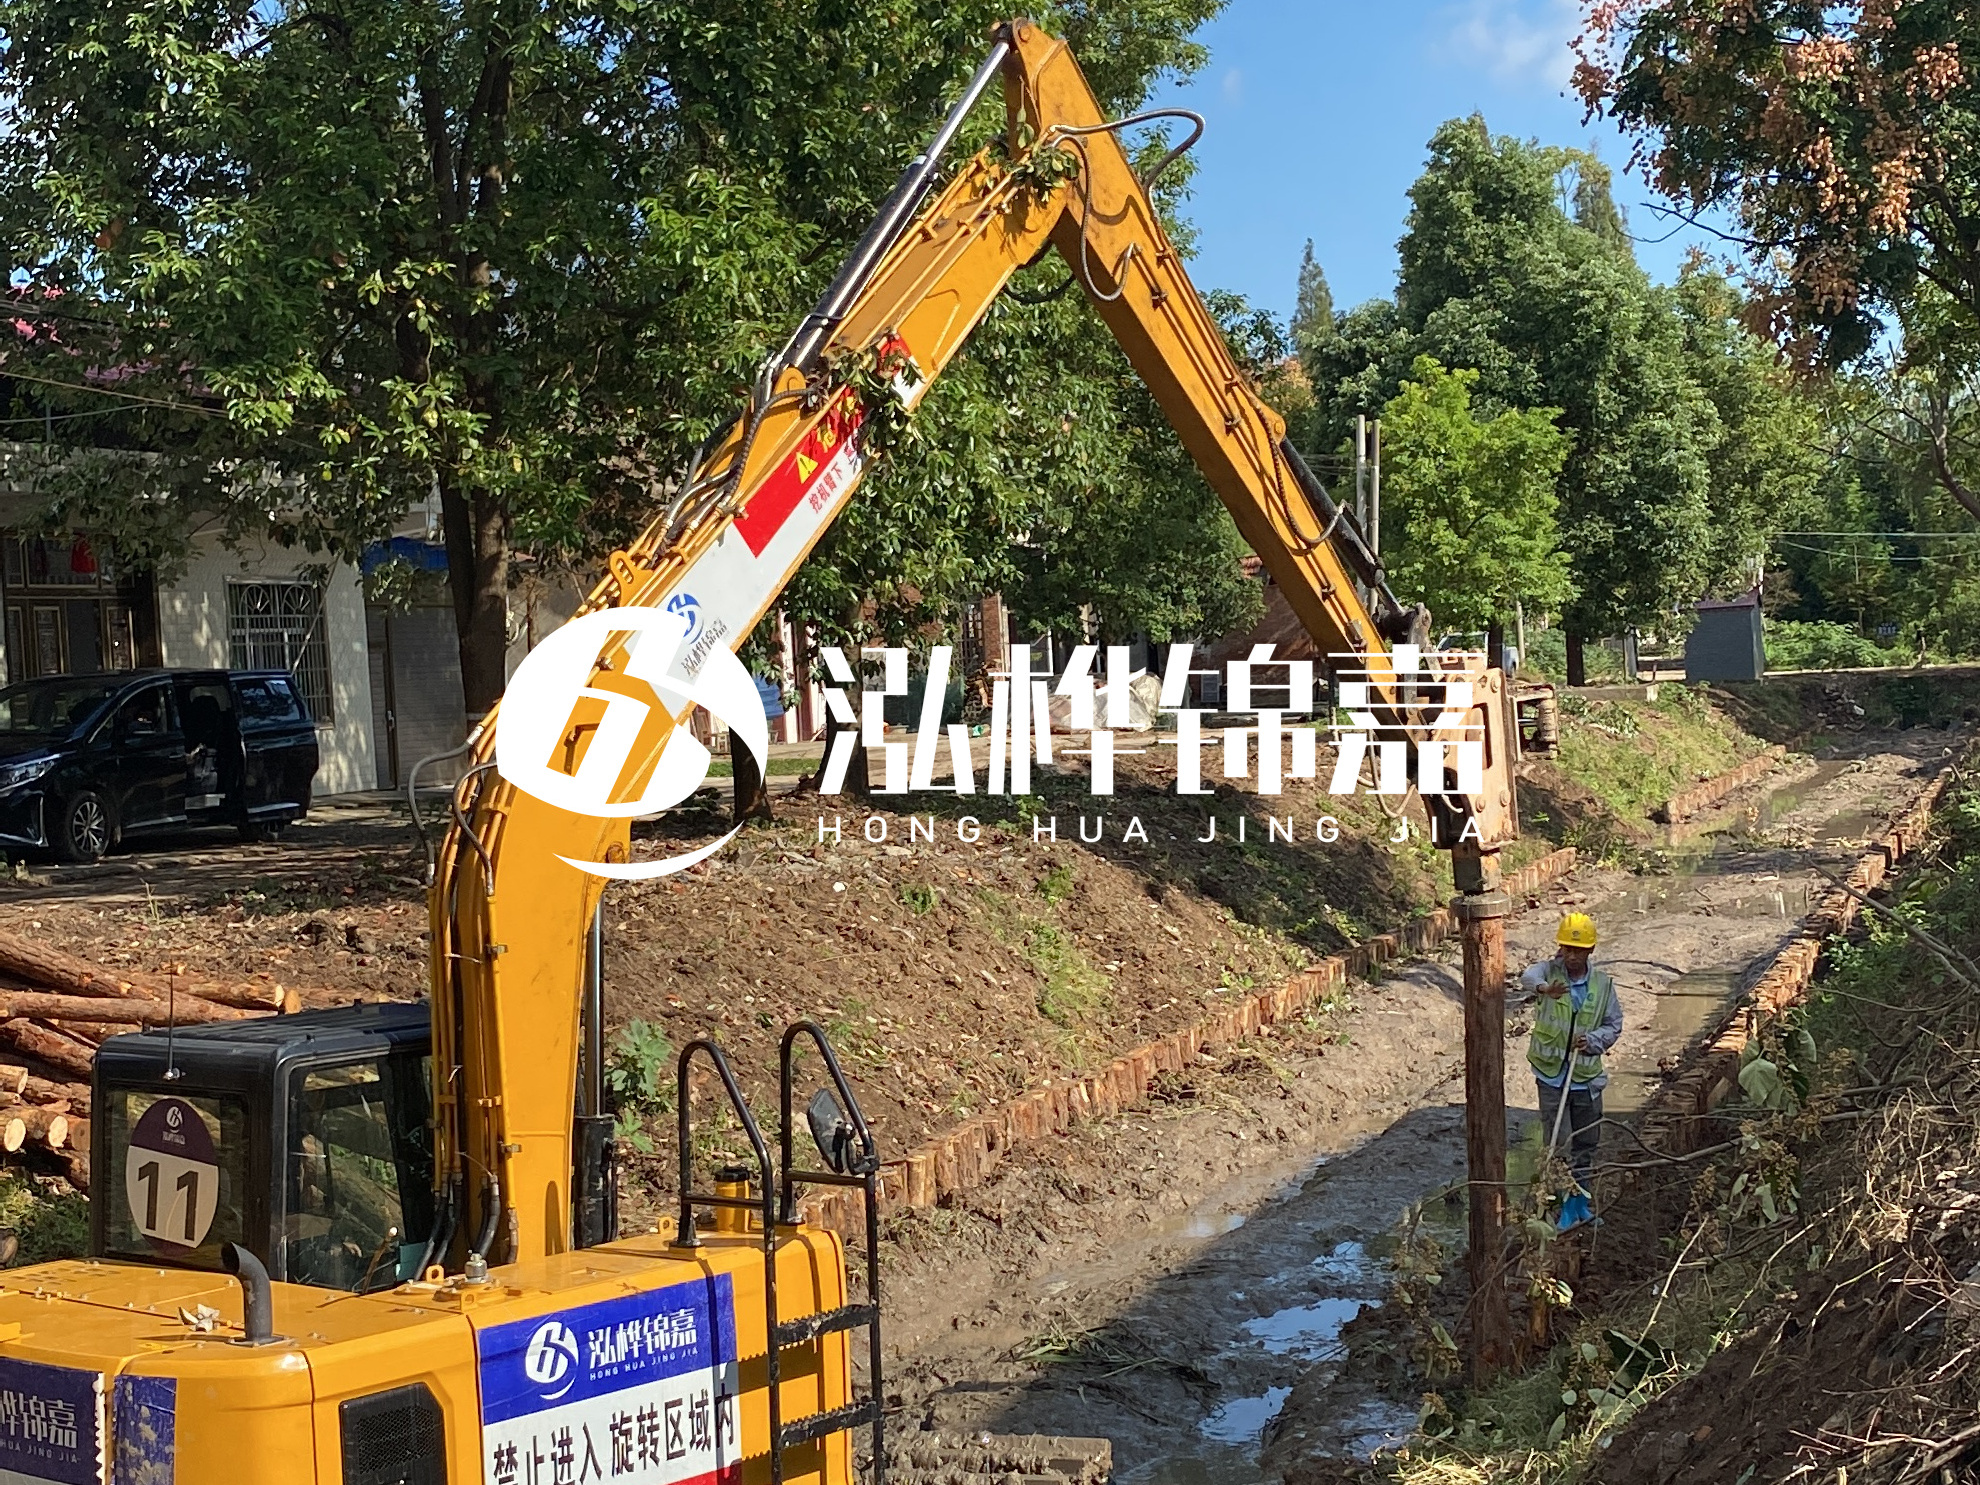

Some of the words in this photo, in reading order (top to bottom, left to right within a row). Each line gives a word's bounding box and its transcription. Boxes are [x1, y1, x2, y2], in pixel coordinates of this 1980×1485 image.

[138, 1161, 199, 1241] 11
[588, 1308, 697, 1369] 泓桦锦嘉
[589, 1367, 619, 1381] HONG
[625, 1361, 646, 1372] HUA
[651, 1353, 676, 1366] JING
[681, 1347, 699, 1359] JIA
[27, 1445, 52, 1459] JING
